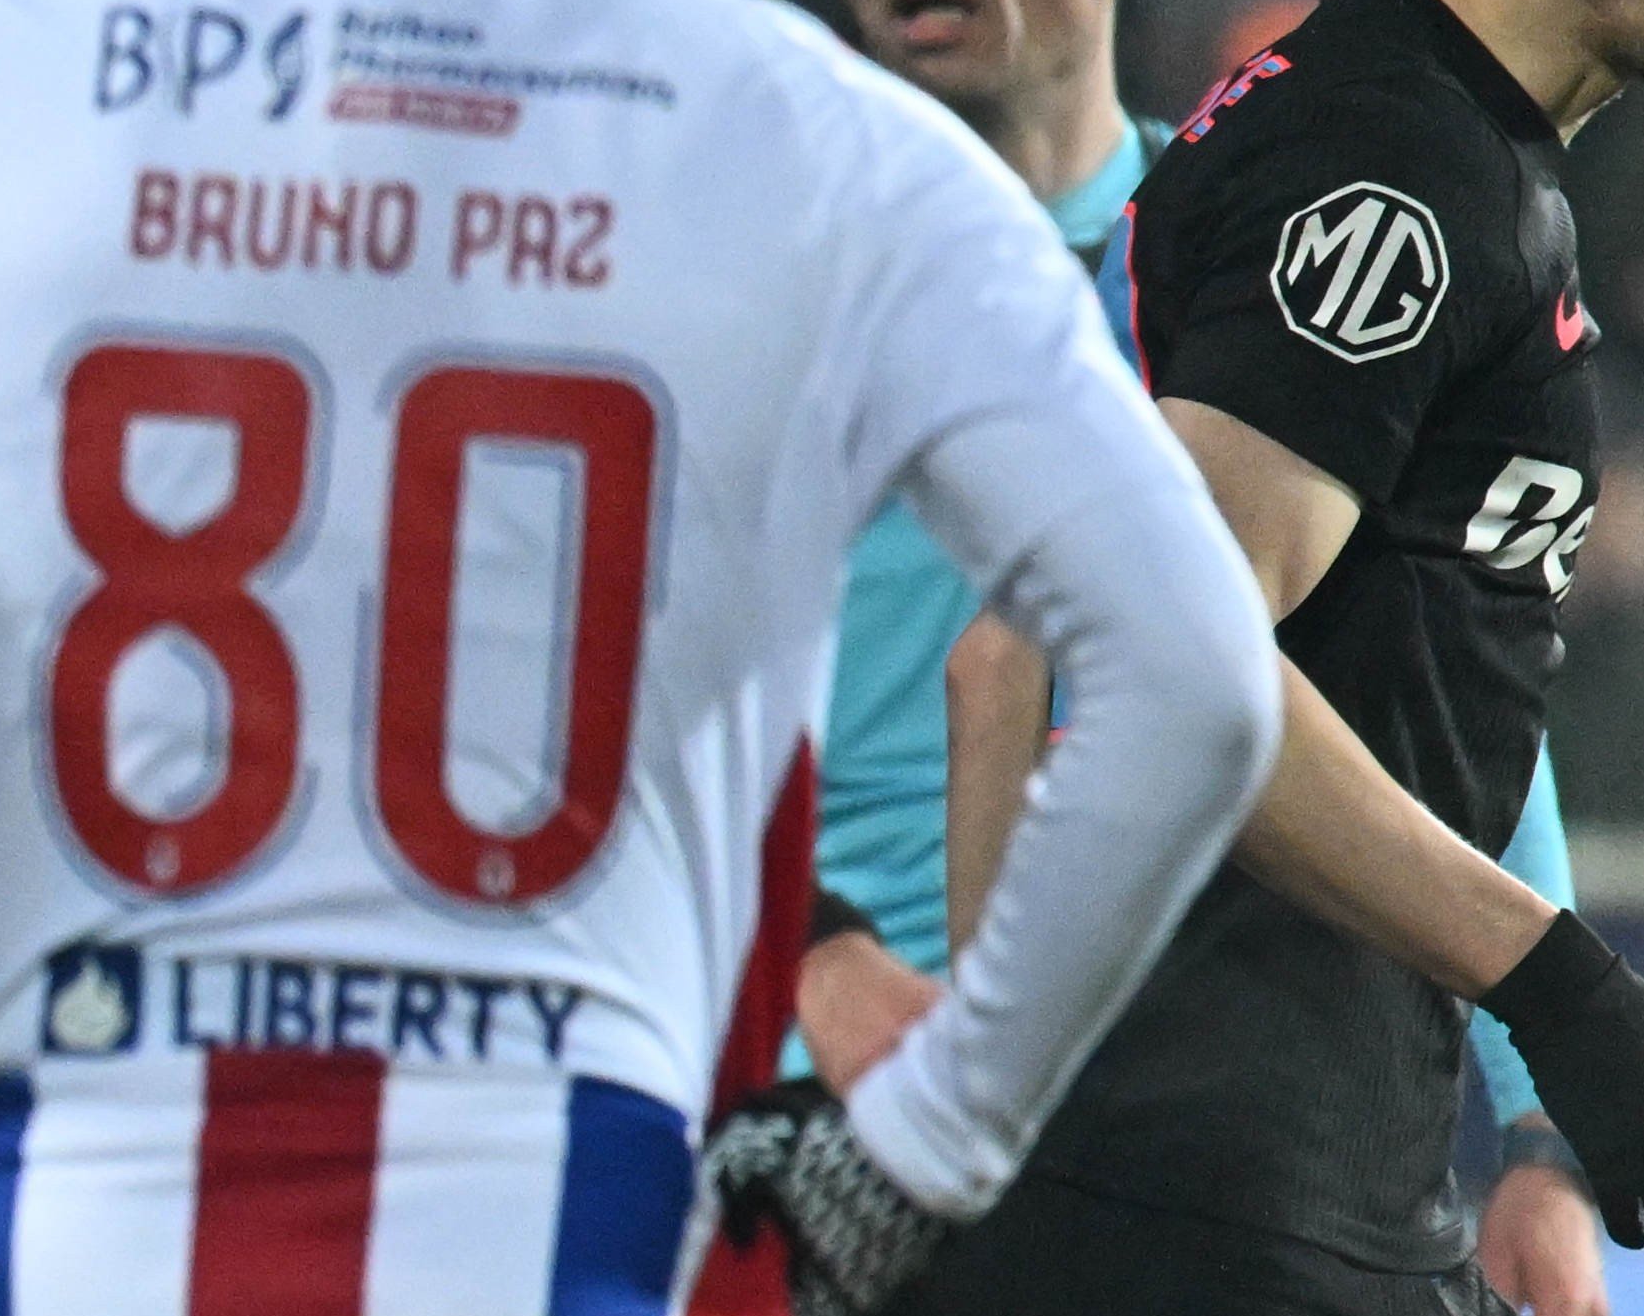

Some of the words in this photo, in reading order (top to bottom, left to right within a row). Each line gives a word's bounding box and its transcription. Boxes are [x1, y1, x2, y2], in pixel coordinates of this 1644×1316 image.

[130, 169, 417, 278] BRUNO
[450, 189, 616, 290] PAZ
[1286, 196, 1435, 345] MG
[1461, 455, 1596, 604] Be
[49, 339, 661, 909] 80
[173, 955, 582, 1062] LIBERTY
